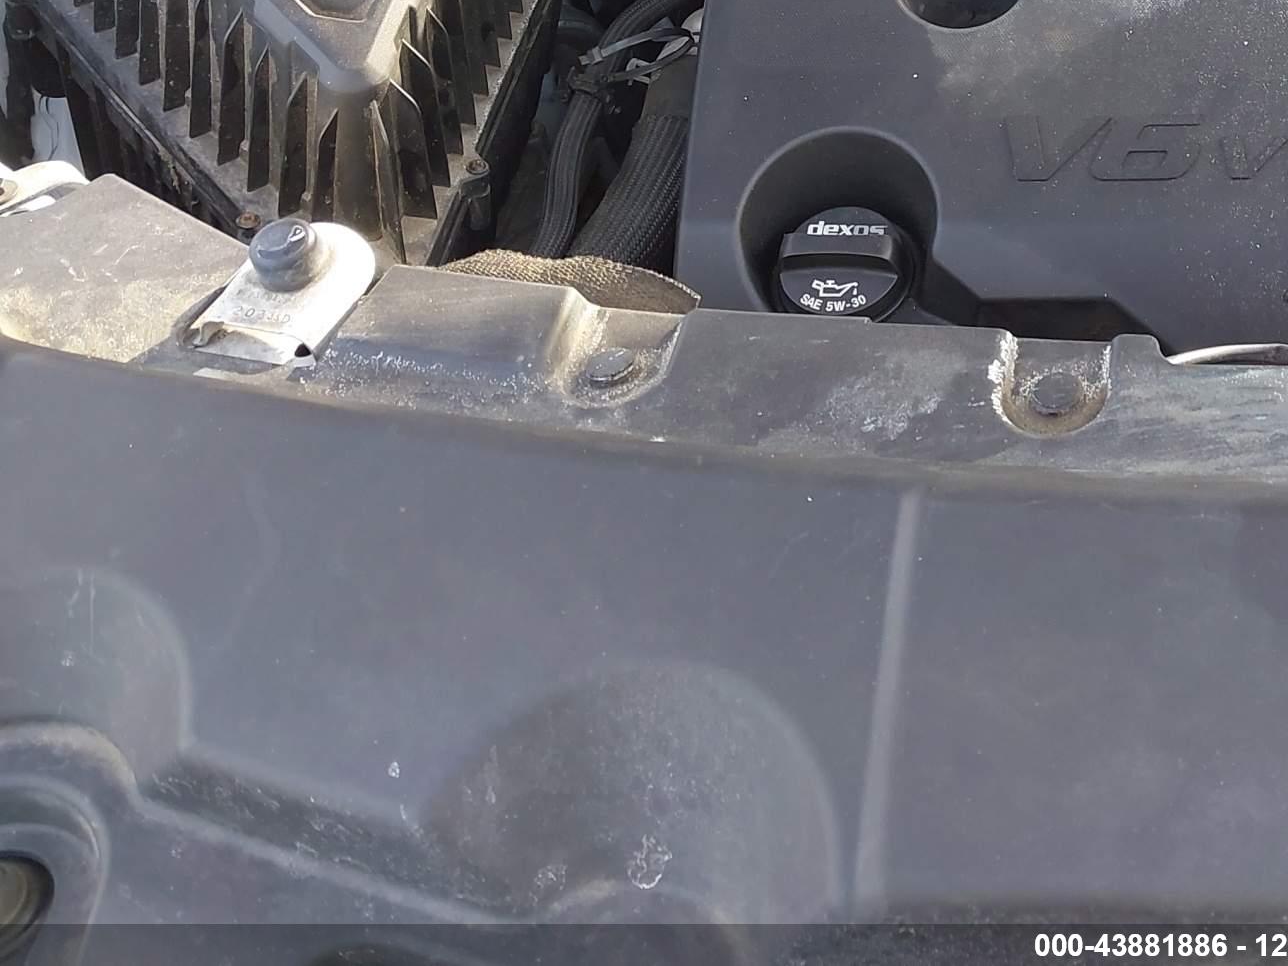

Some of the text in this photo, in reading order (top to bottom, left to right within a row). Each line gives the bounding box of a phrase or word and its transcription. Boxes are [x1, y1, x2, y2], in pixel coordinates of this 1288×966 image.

[1003, 116, 1207, 182] V6
[807, 220, 888, 236] dexos
[800, 293, 867, 312] SAE 5W-30
